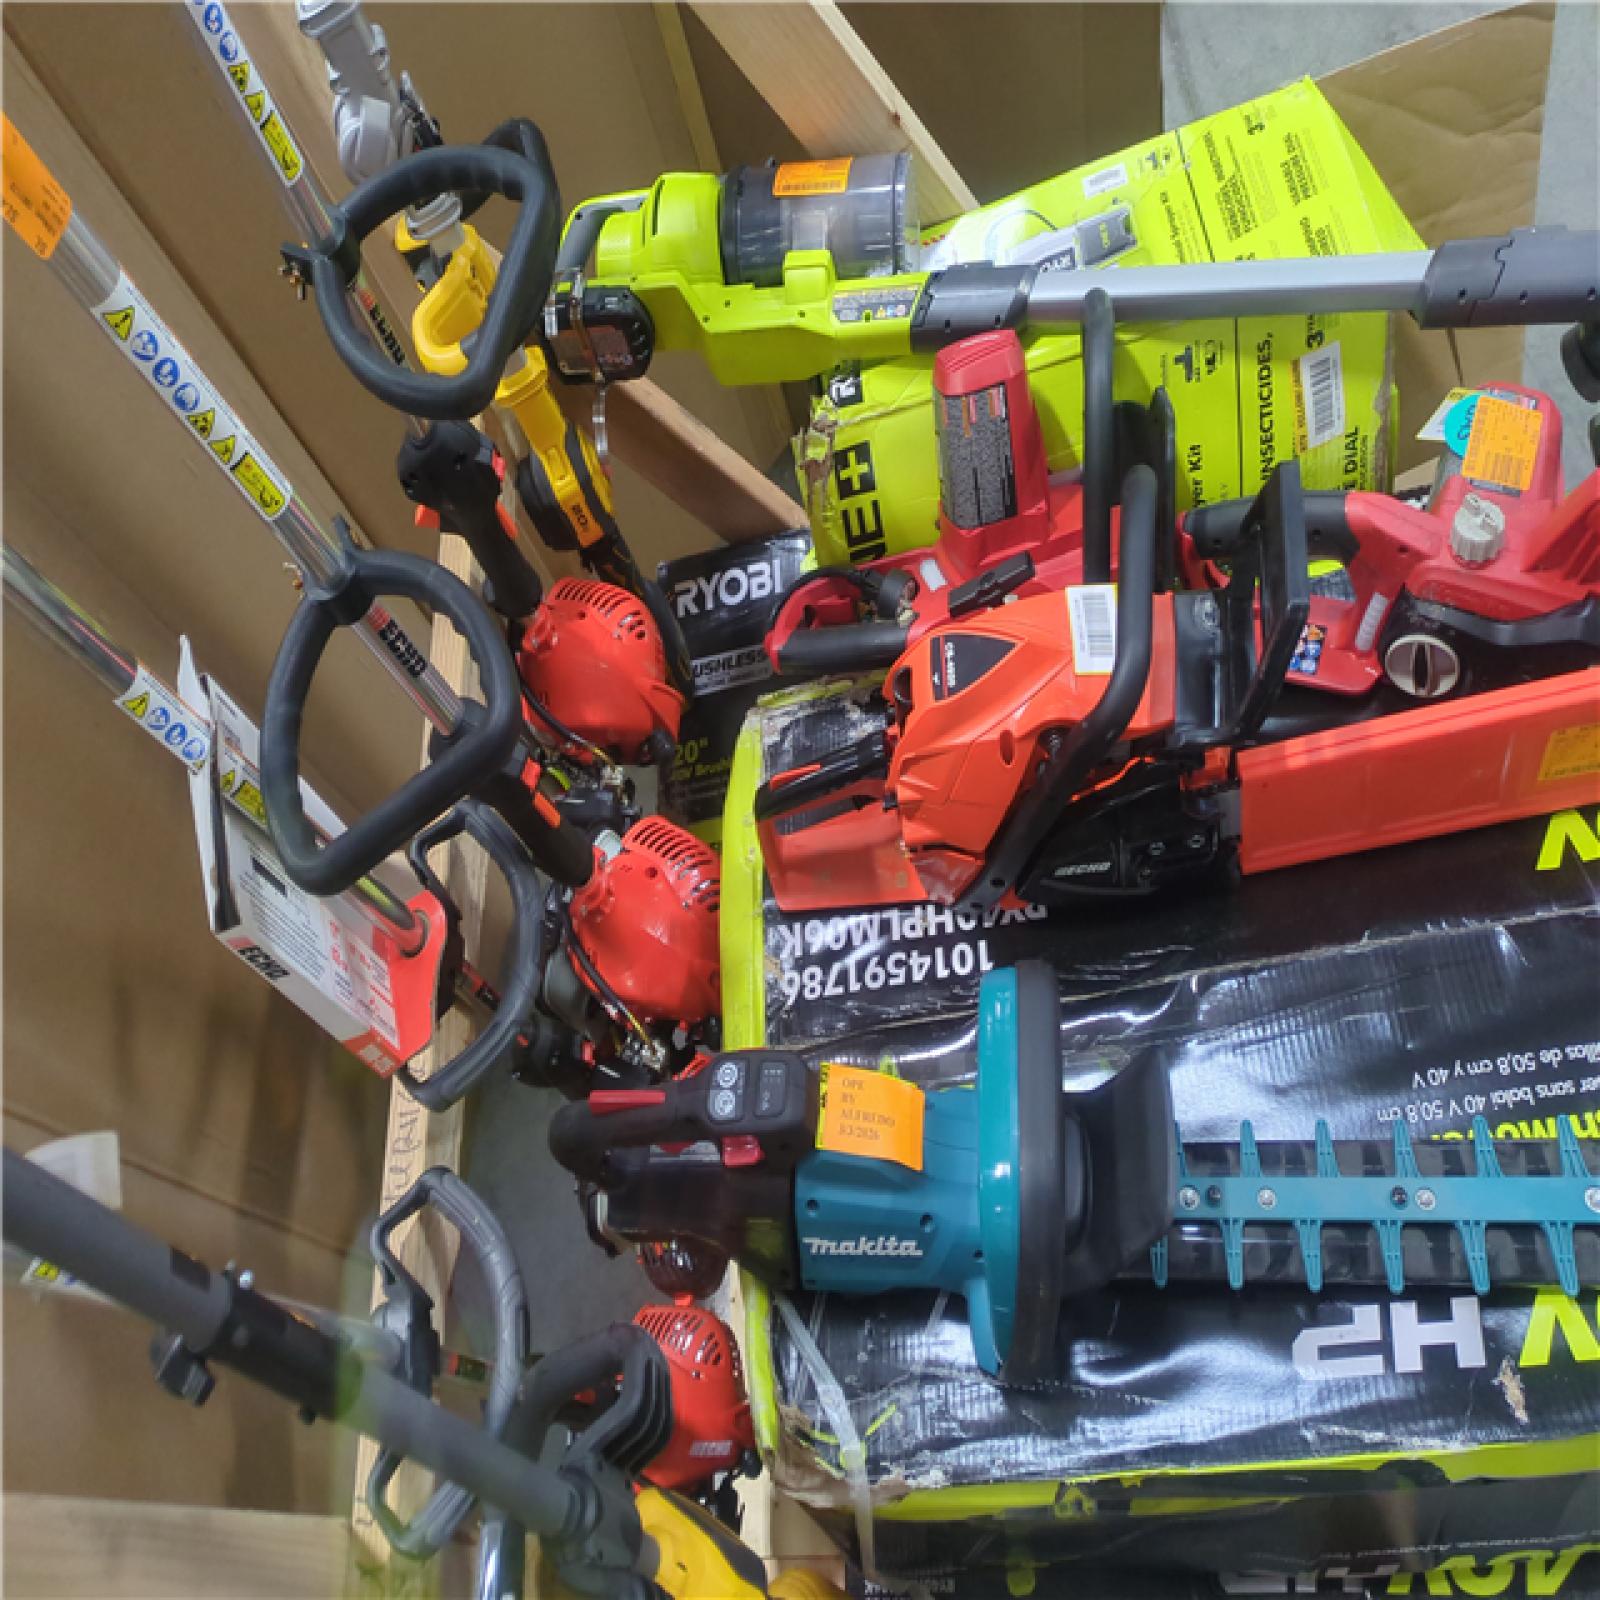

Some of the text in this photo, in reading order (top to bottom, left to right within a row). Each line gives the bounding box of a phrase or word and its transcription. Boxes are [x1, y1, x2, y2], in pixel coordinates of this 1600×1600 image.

[1187, 444, 1203, 472] Kit
[1345, 426, 1360, 475] DIAL
[674, 559, 783, 618] RYOBI
[378, 617, 427, 678] ECHO
[237, 944, 290, 980] ECHO
[780, 939, 995, 1007] 1014591786
[1467, 1058, 1494, 1076] cm
[1497, 1052, 1537, 1075] 50,8
[1539, 1047, 1563, 1068] de
[1405, 1098, 1444, 1124] 50,8
[1490, 1086, 1536, 1111] balai
[802, 1235, 924, 1257] makita
[1291, 1295, 1487, 1382] HP
